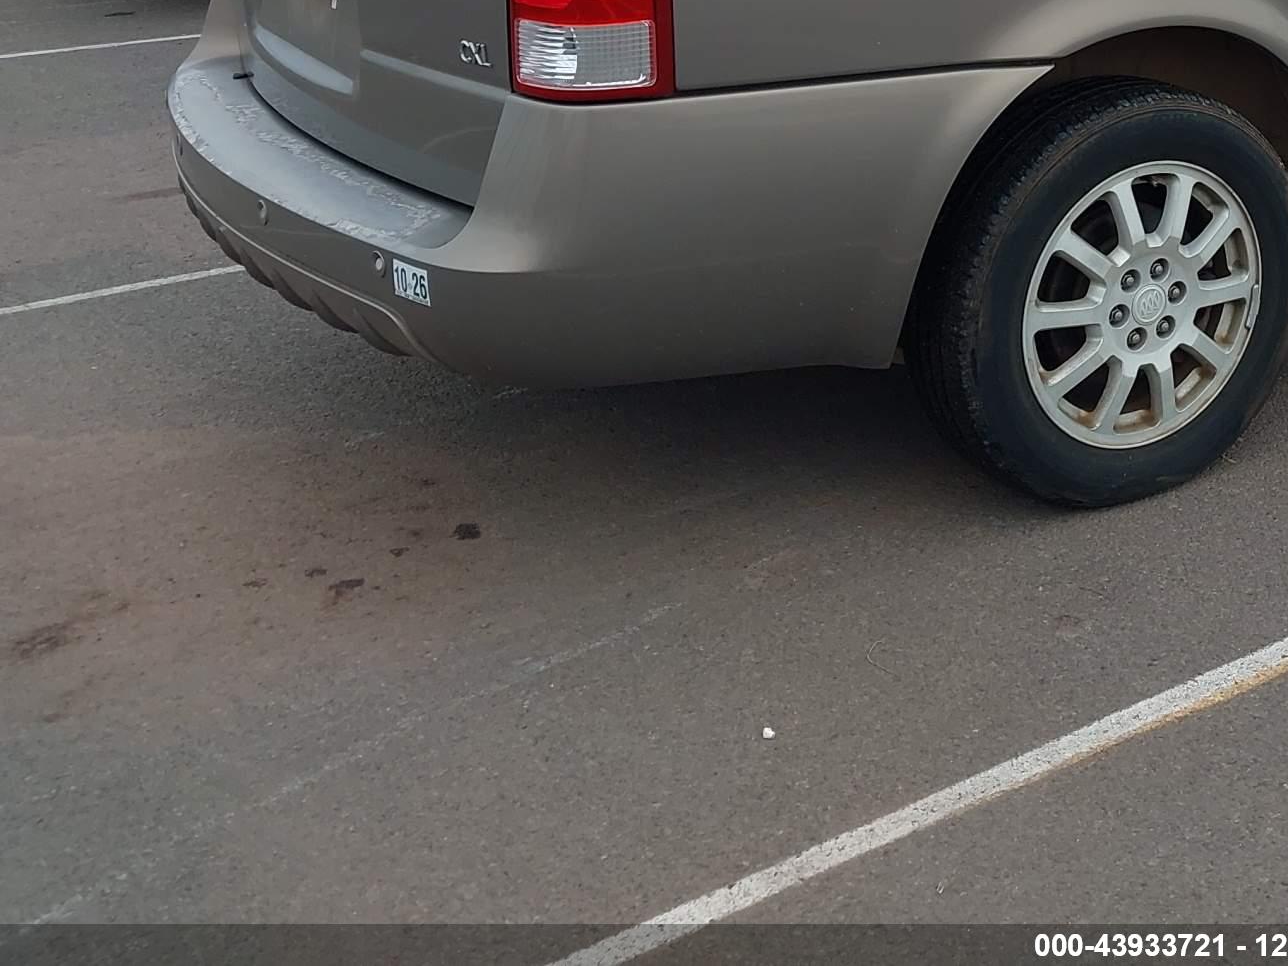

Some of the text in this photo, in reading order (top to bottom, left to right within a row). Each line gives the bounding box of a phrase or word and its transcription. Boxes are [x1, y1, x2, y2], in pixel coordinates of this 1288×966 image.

[459, 39, 491, 67] CXL
[394, 265, 408, 293] 10
[411, 272, 428, 300] 26
